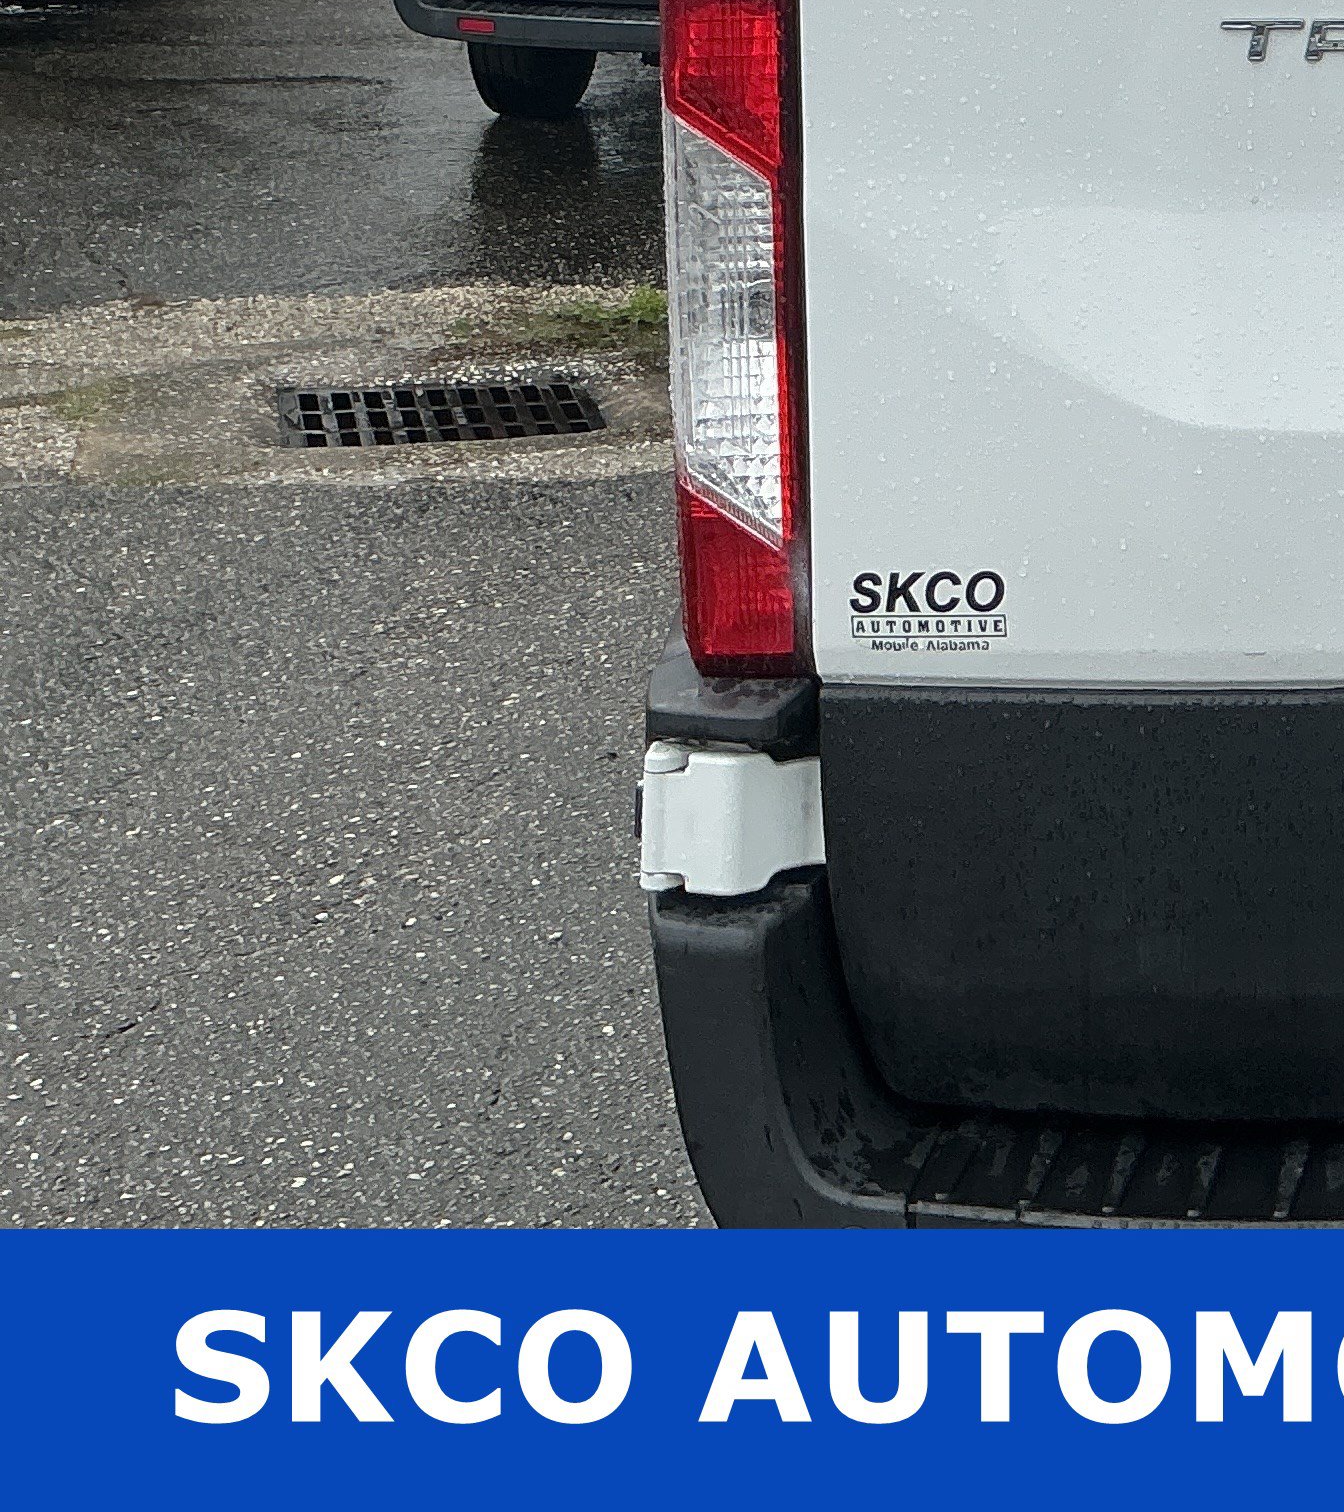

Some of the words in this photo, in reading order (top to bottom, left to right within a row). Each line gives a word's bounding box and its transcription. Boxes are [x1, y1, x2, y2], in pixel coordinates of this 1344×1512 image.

[849, 570, 1005, 614] SKCO
[855, 619, 1003, 634] AUTOMOTIVE
[926, 639, 990, 652] Alabama
